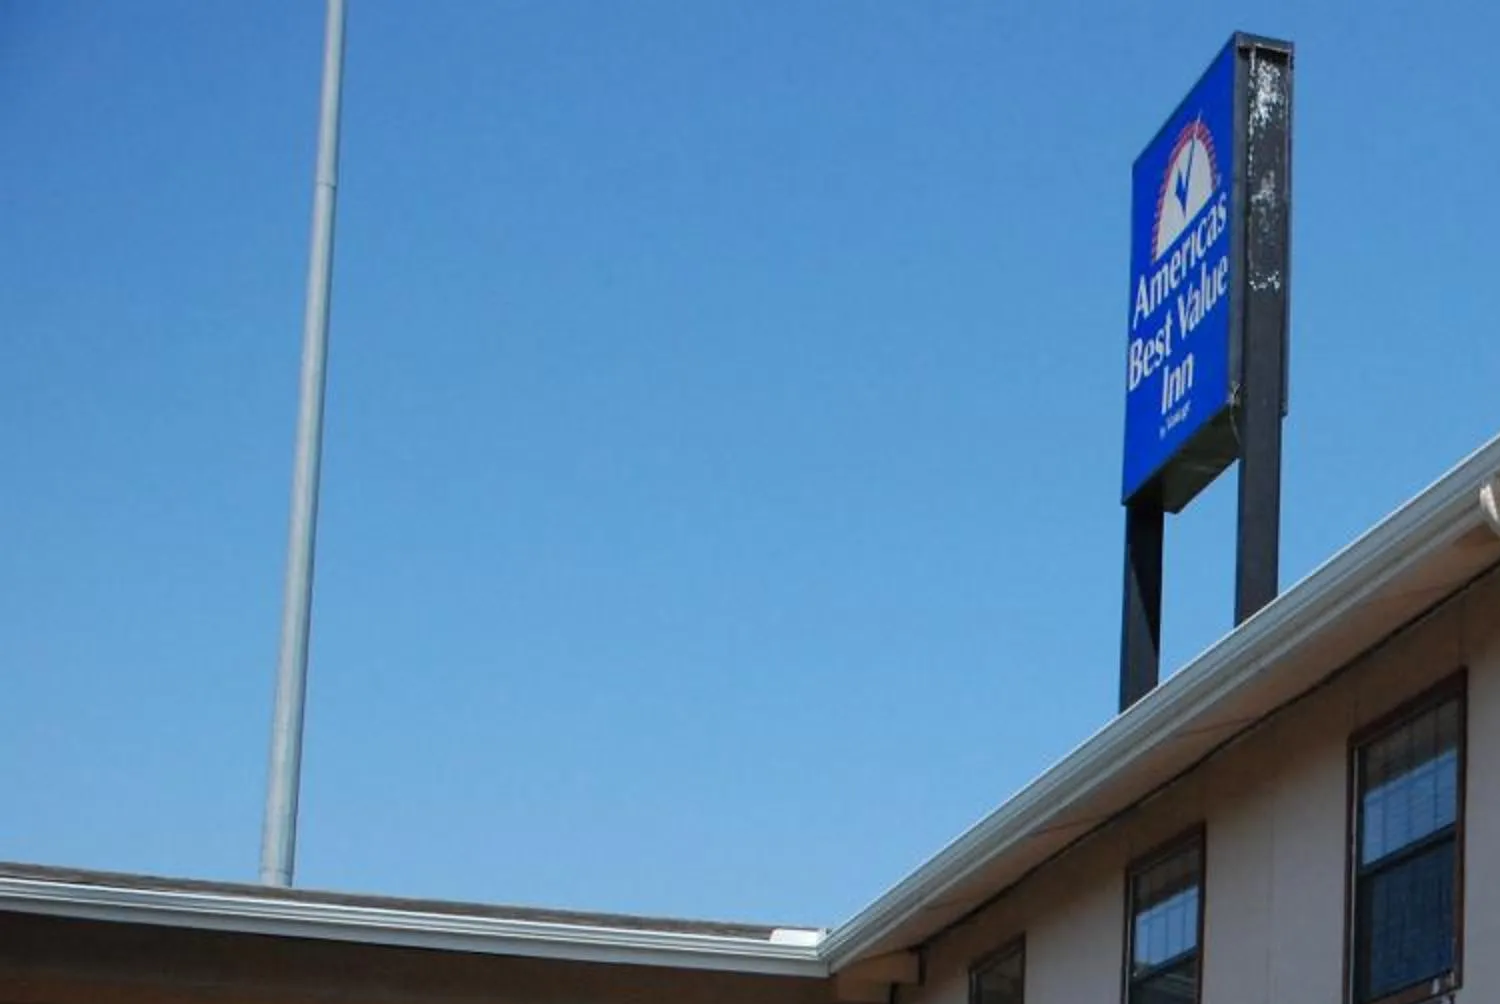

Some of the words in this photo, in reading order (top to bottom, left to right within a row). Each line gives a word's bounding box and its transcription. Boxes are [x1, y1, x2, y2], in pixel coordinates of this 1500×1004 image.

[1128, 309, 1173, 391] Best
[1177, 255, 1228, 340] Value
[1132, 192, 1227, 328] Americas
[1161, 352, 1194, 415] Inn
